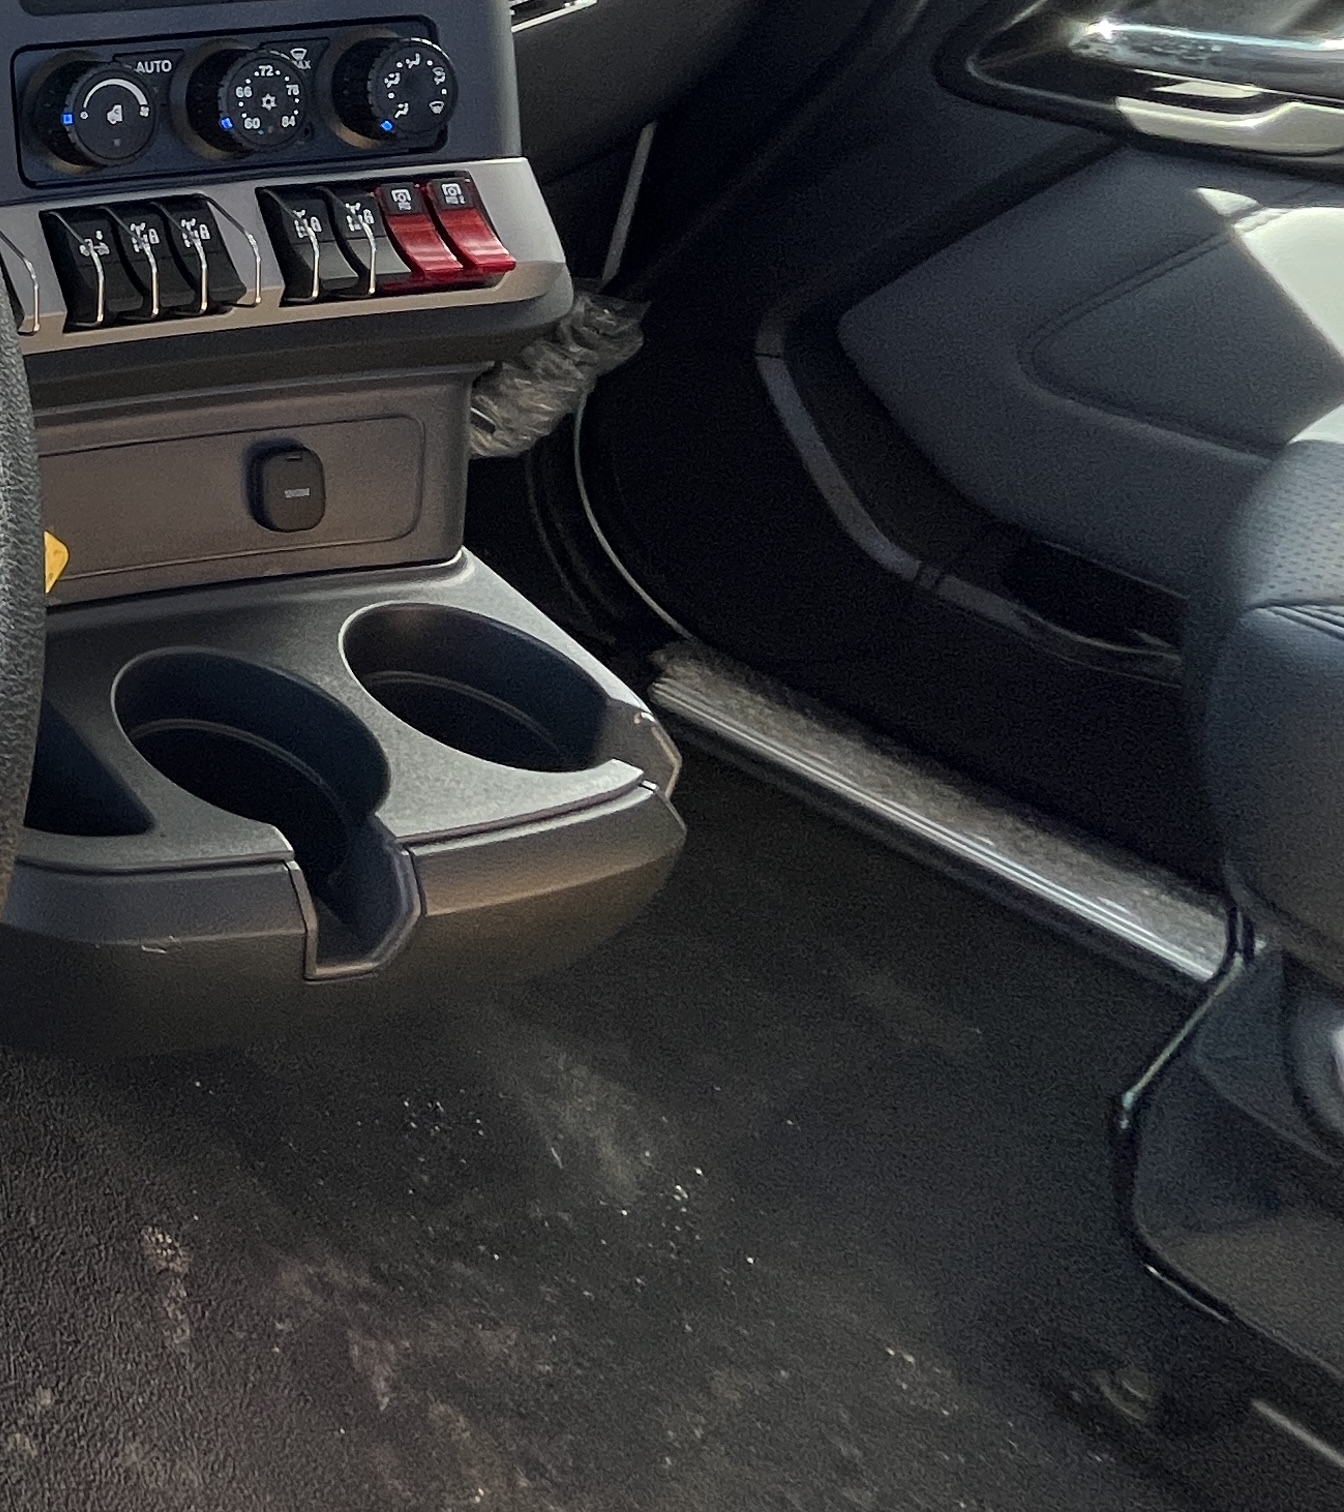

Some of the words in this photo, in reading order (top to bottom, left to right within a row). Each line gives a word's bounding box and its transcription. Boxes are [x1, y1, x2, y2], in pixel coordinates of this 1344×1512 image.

[135, 58, 173, 74] AUTO
[258, 64, 275, 77] 72
[243, 117, 261, 130] 60
